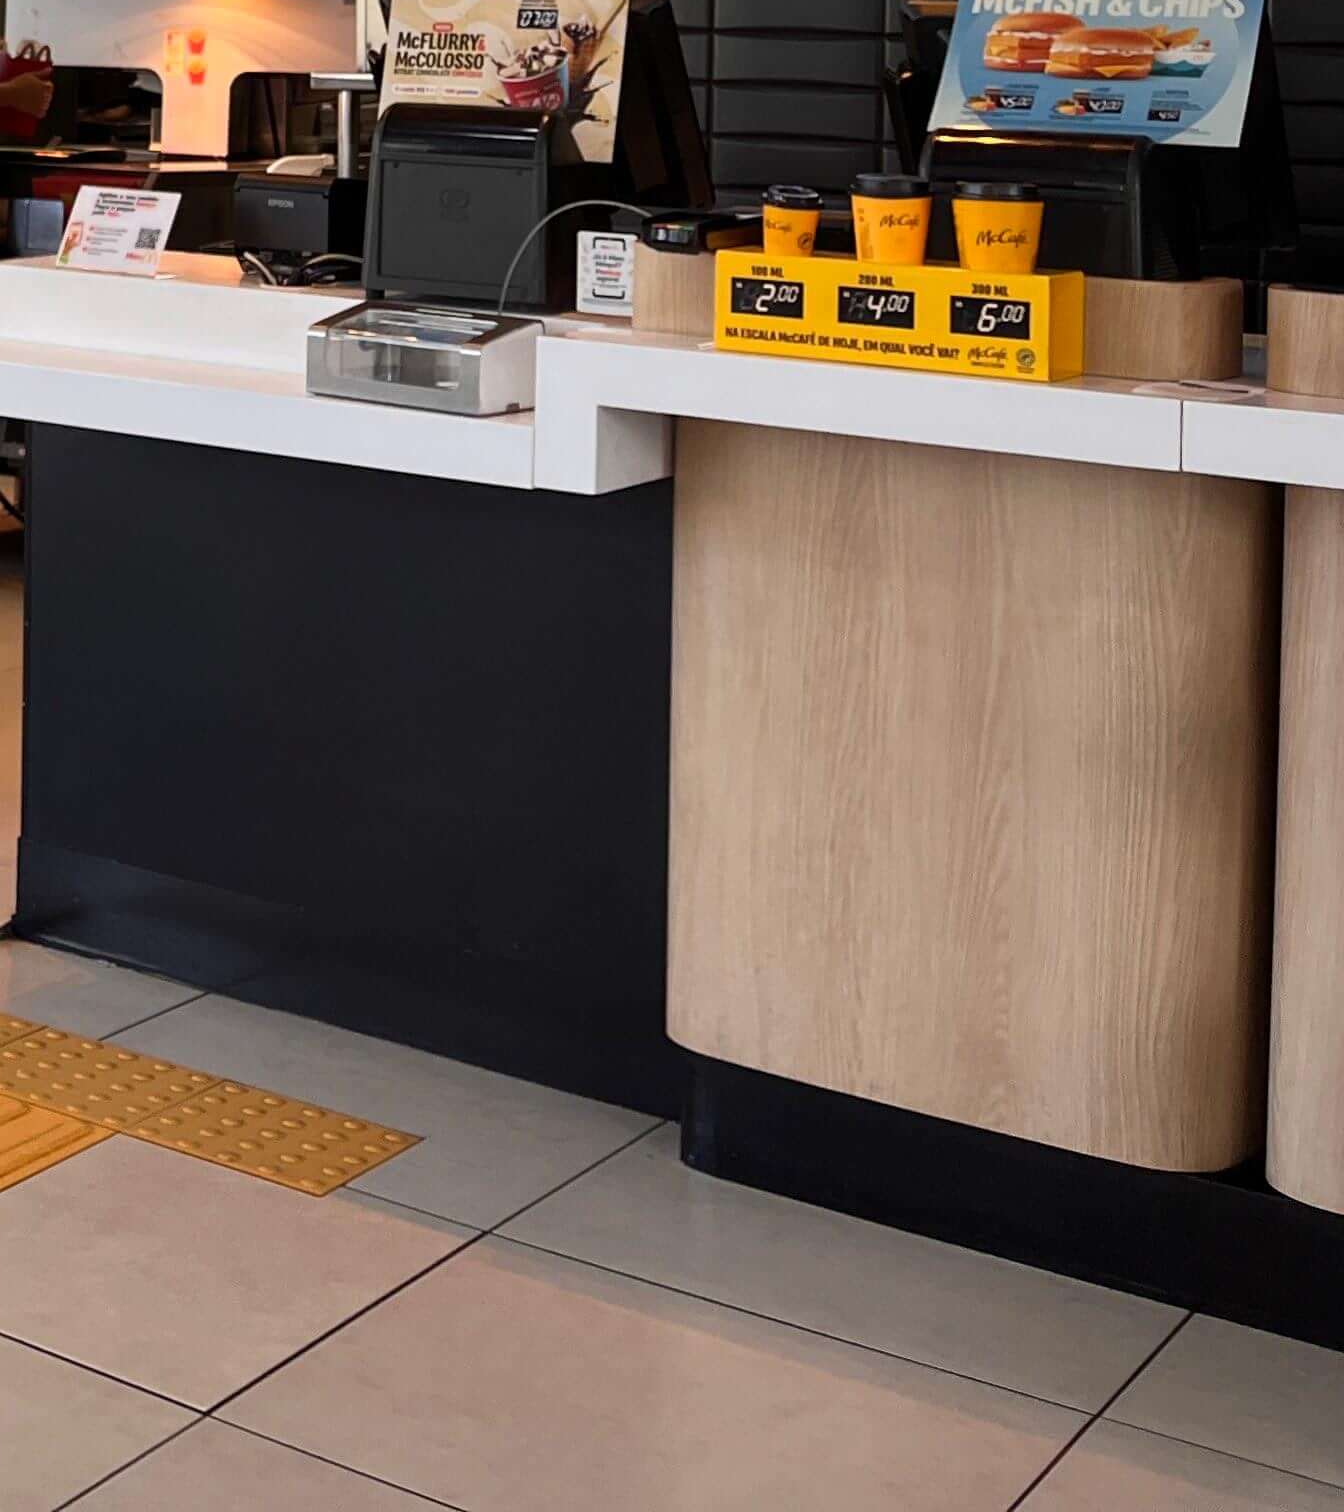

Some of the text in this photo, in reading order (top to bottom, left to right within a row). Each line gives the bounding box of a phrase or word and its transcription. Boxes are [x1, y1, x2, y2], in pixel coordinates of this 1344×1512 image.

[395, 51, 485, 70] McCOLOSSO
[740, 327, 778, 342] ESCALA
[818, 335, 831, 346] DE
[879, 342, 907, 355] QUAL
